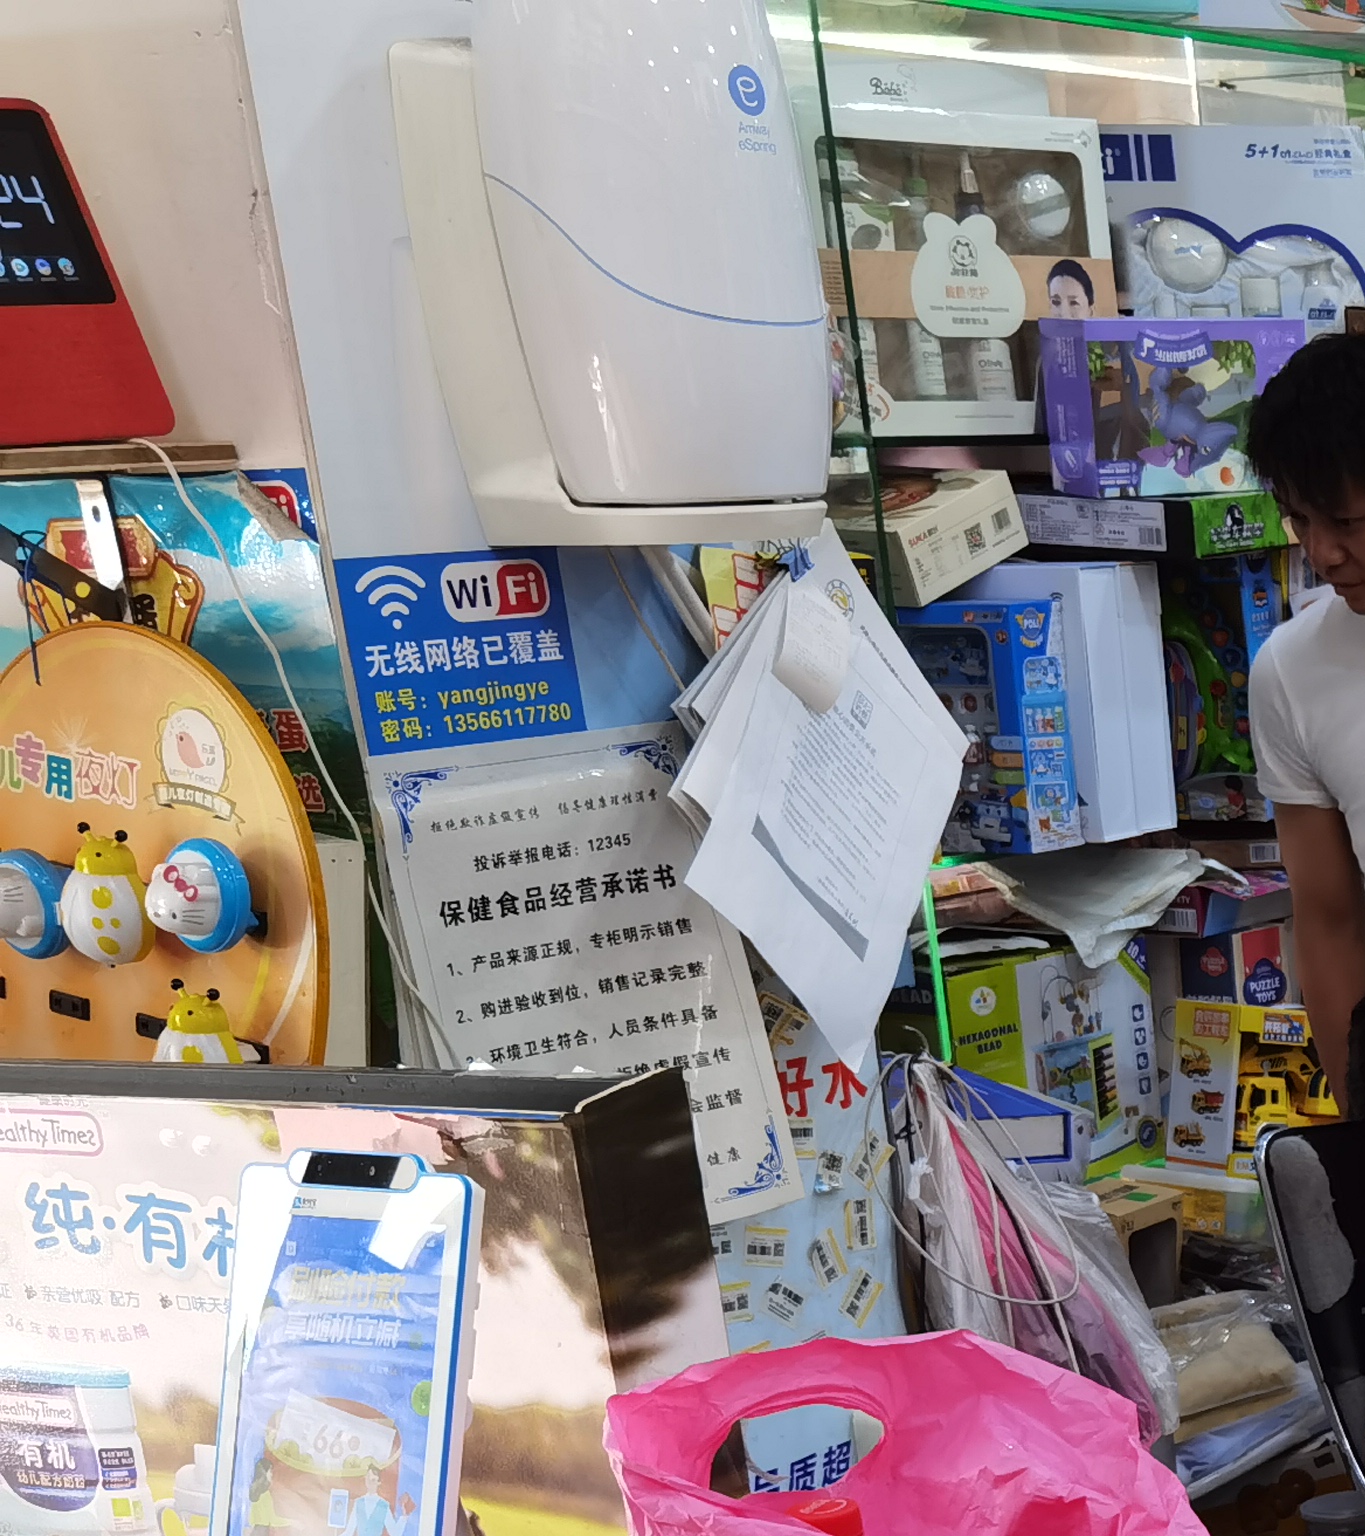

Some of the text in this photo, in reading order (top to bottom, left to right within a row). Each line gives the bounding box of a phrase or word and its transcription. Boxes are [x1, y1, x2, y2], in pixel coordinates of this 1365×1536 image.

[446, 568, 541, 612] WiFi
[364, 629, 565, 678] 无线网络已覆盖
[438, 863, 678, 929] 保健食品经营承诺书
[446, 917, 693, 978] 1、产品来源正规，专柜明示销售
[455, 959, 710, 1023] 2、购进验收到位，销售记录完整
[1249, 976, 1282, 992] PUZZLE
[1256, 990, 1277, 1003] TOYS
[465, 1004, 719, 1067] 3环境卫生符合，人员条件具备
[958, 1022, 1019, 1049] HEXAGONAL
[976, 1038, 1004, 1055] BEAD
[285, 1312, 402, 1350] 享随机立减
[18, 1440, 77, 1470] 有机
